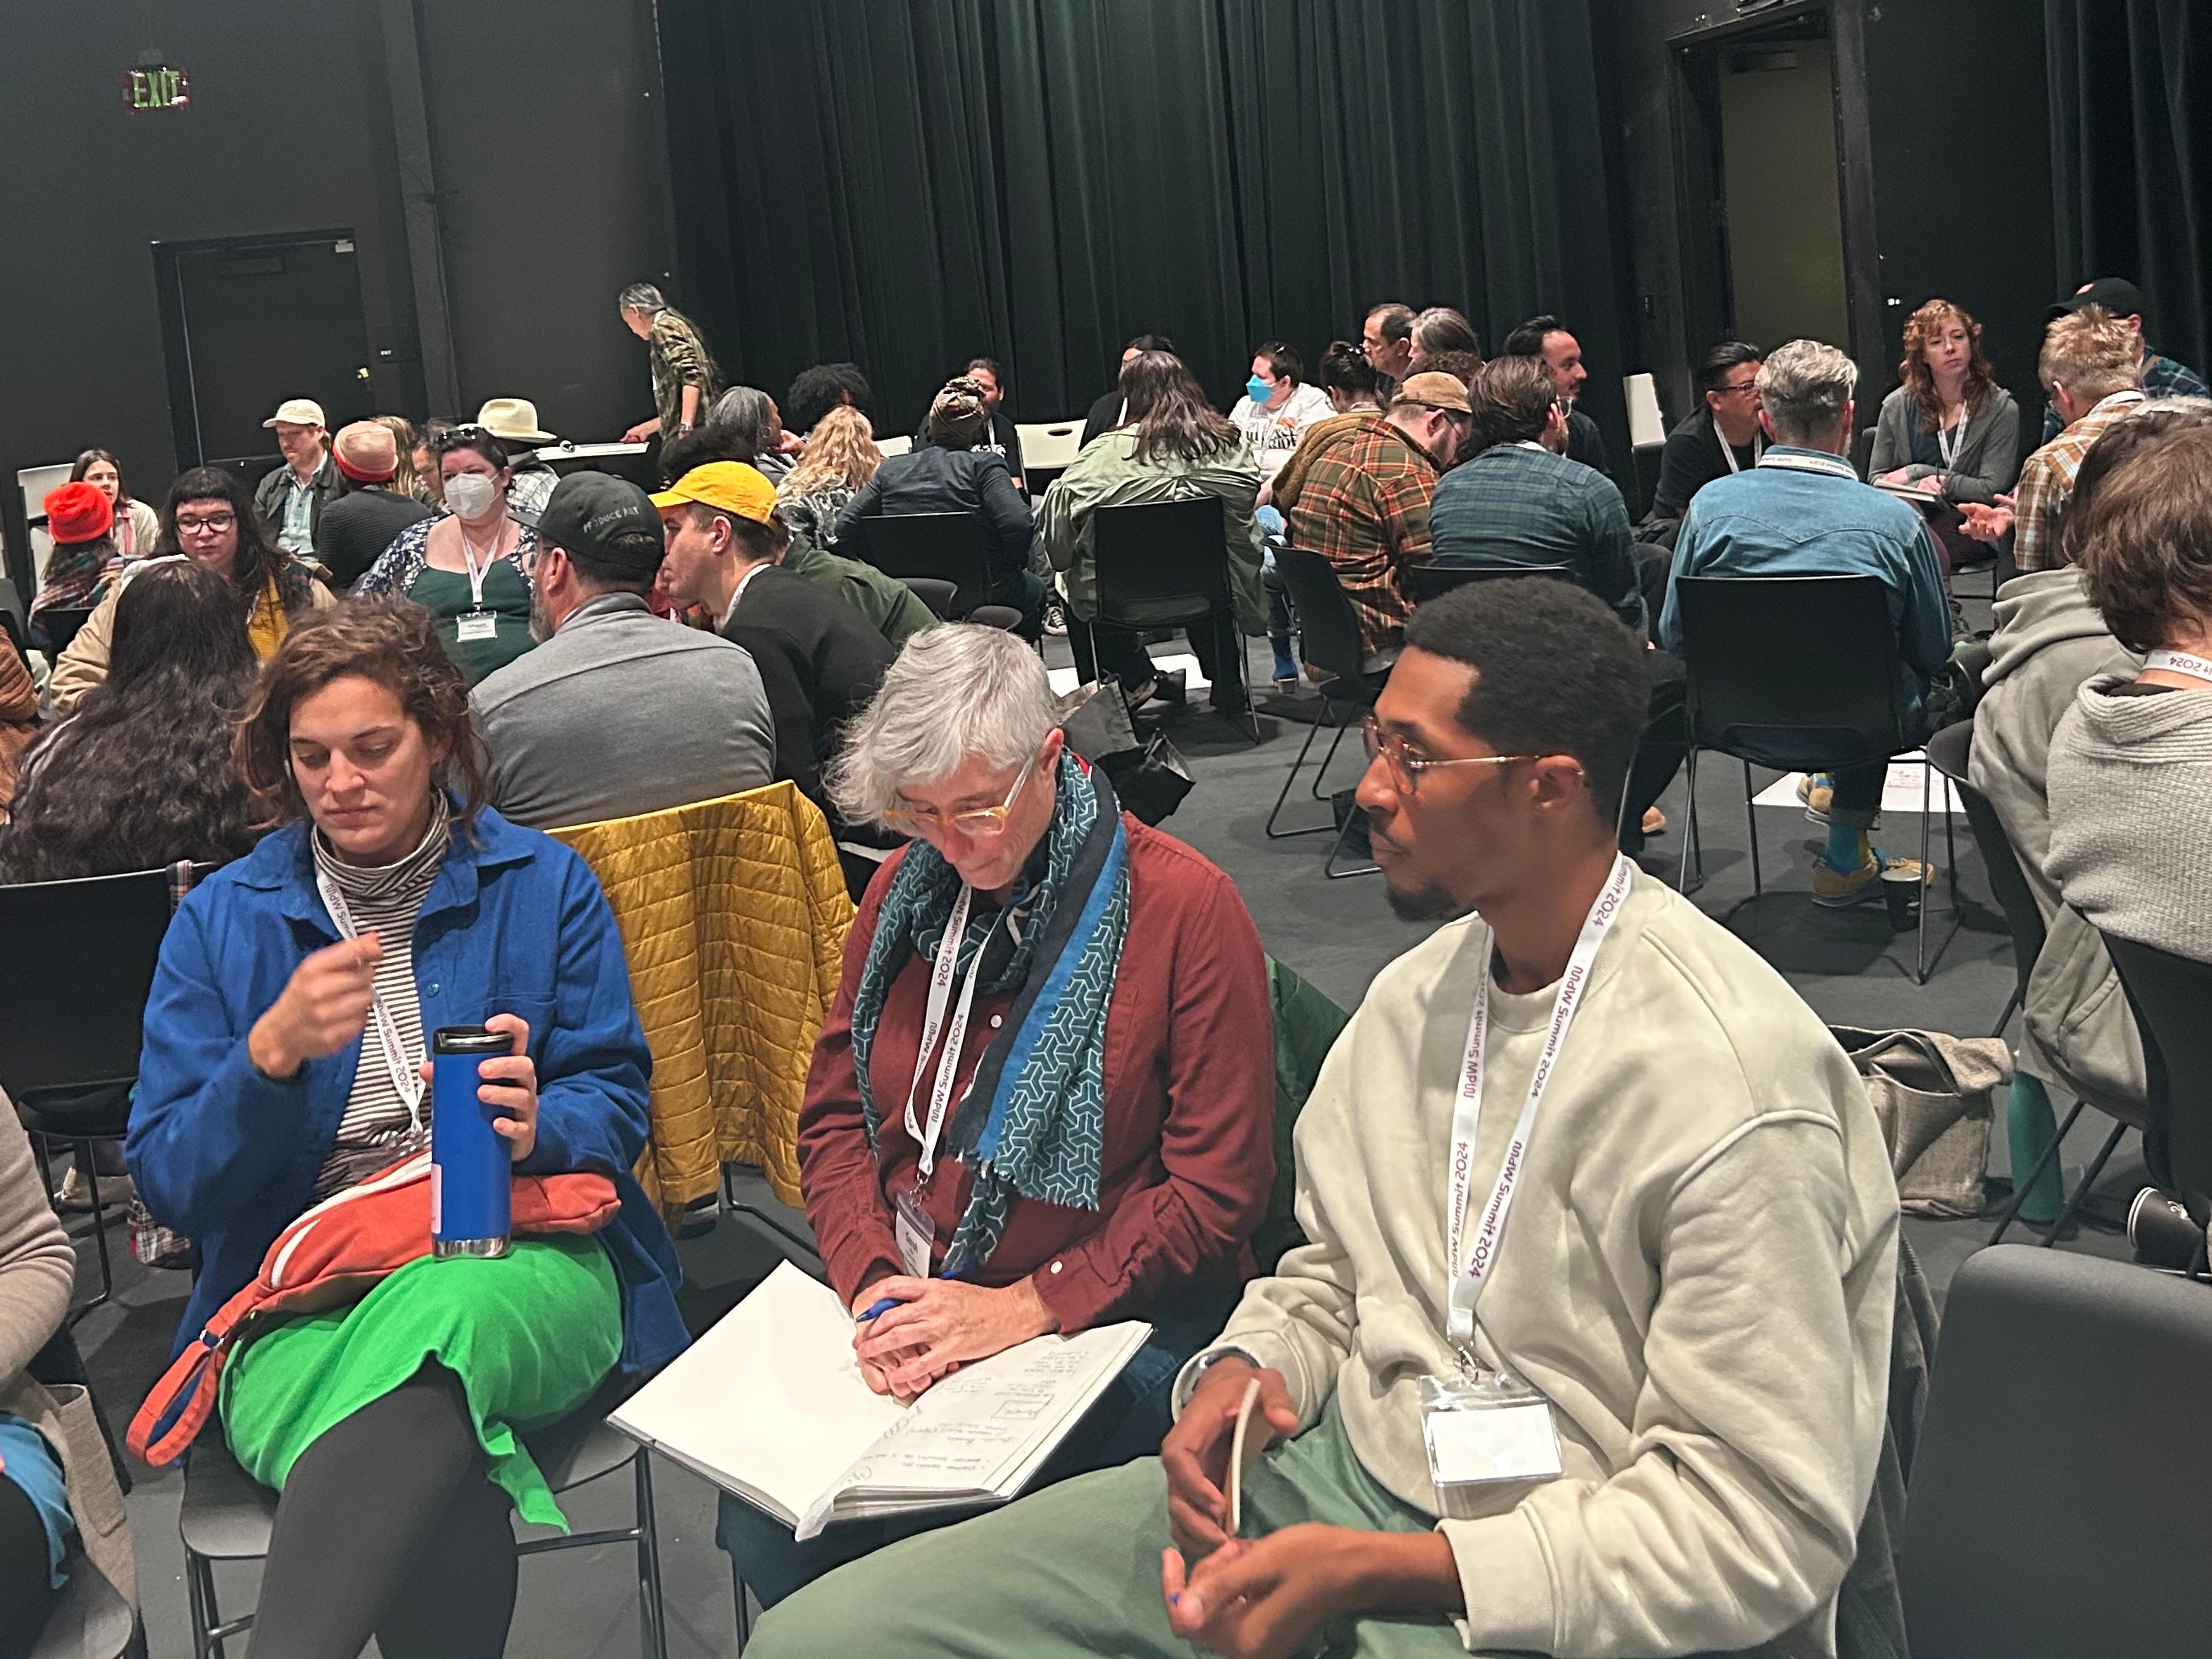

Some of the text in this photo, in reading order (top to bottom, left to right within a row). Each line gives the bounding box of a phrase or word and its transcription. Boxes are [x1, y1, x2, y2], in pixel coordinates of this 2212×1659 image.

[131, 70, 179, 107] EXIT
[2170, 656, 2202, 672] 2024
[337, 911, 353, 939] Summ
[1593, 893, 1619, 926] 2024
[945, 915, 962, 955] Summit
[937, 957, 952, 986] 2024
[939, 1047, 956, 1089] Summit
[951, 1014, 964, 1045] 2024
[1469, 1009, 1484, 1058] Summit
[1546, 1006, 1568, 1057] Summit
[383, 1028, 402, 1064] Summit
[396, 1066, 410, 1093] 2024
[1532, 1060, 1550, 1098] 2024
[1455, 1142, 1468, 1181] 2024
[1452, 1183, 1463, 1235] Summit
[1483, 1183, 1510, 1236] Summit
[1469, 1237, 1492, 1277] 2024
